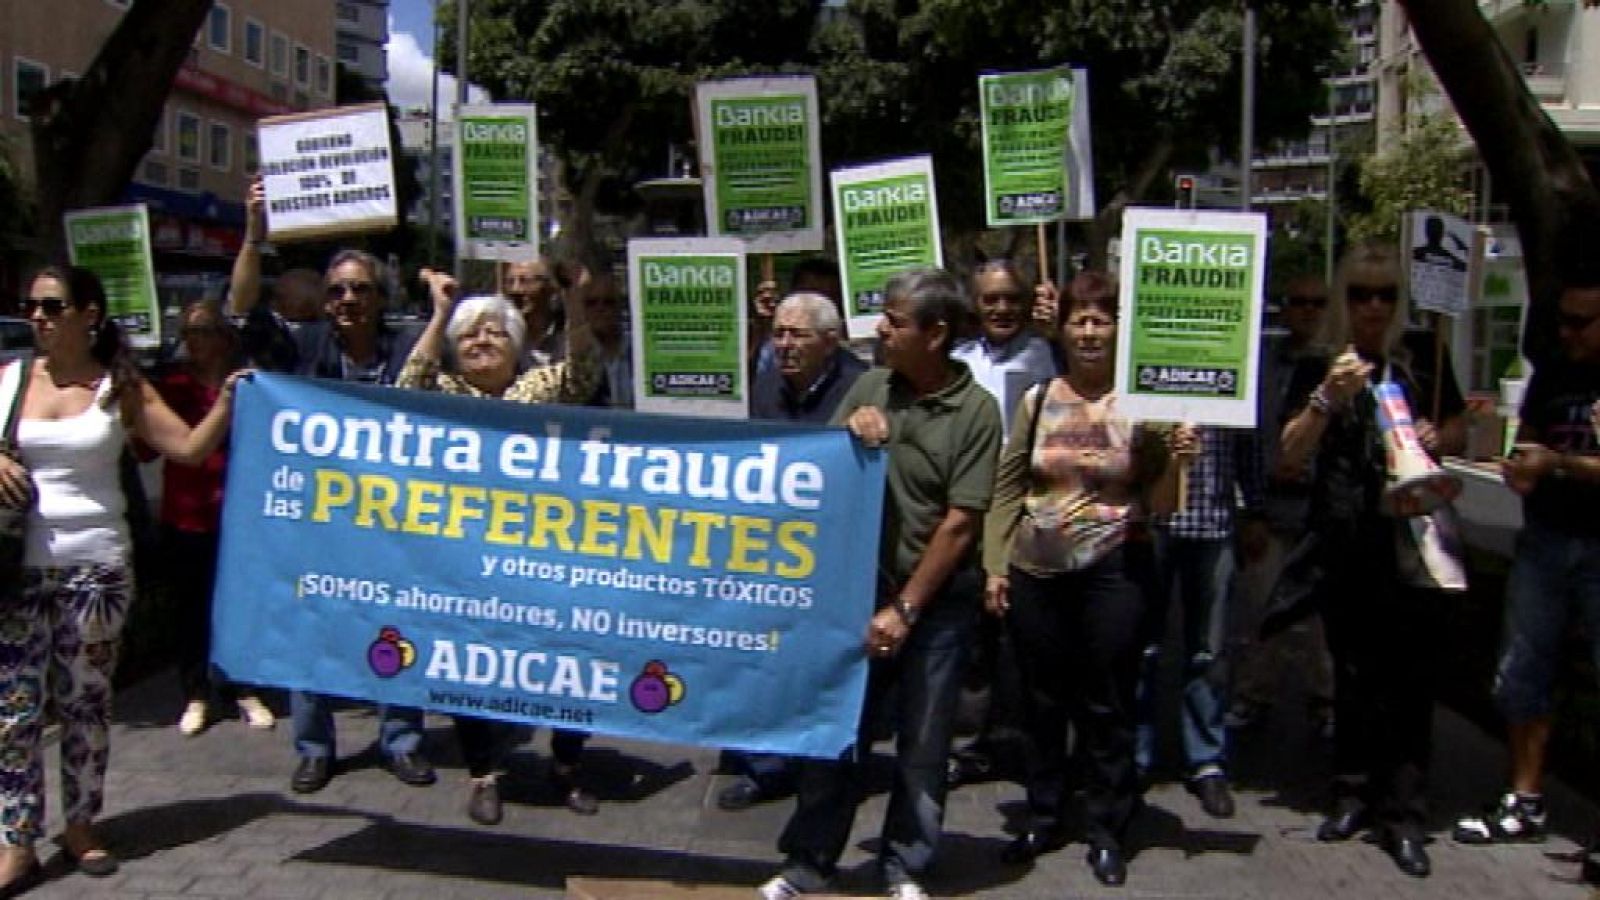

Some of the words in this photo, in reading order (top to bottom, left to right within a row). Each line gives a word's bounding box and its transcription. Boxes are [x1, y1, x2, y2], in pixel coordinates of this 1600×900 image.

[717, 104, 805, 128] Bankia
[464, 122, 526, 144] Bankia
[718, 125, 804, 145] FRAUDE!
[299, 174, 333, 191] 100%
[341, 170, 356, 185] DE
[271, 193, 332, 213] NUESTROS
[844, 184, 926, 213] Bankia
[847, 203, 926, 229] FRAUDE!
[1140, 237, 1249, 267] Bankia
[644, 262, 733, 288] Bankia
[1140, 266, 1246, 289] FRAUDE!
[646, 288, 732, 305] FRAUDE!
[1137, 305, 1242, 322] PREFERENTES
[668, 374, 717, 386] ADICAE
[1158, 368, 1217, 383] ADICAE
[271, 409, 482, 473] contra
[499, 422, 561, 482] el
[580, 426, 824, 510] fraude
[271, 465, 305, 492] de
[263, 491, 303, 520] las
[311, 469, 818, 579] PREFERENTES
[481, 557, 496, 576] y
[502, 556, 565, 582] otros
[569, 565, 698, 597] productos
[702, 575, 814, 608] TÓXICOS
[295, 573, 391, 605] ¡SOMOS
[395, 586, 564, 630] ahorradores,
[571, 606, 611, 635] NO
[616, 612, 780, 652] inversores!
[425, 640, 620, 701] ADICAE
[429, 688, 593, 723] www.adicae.net
